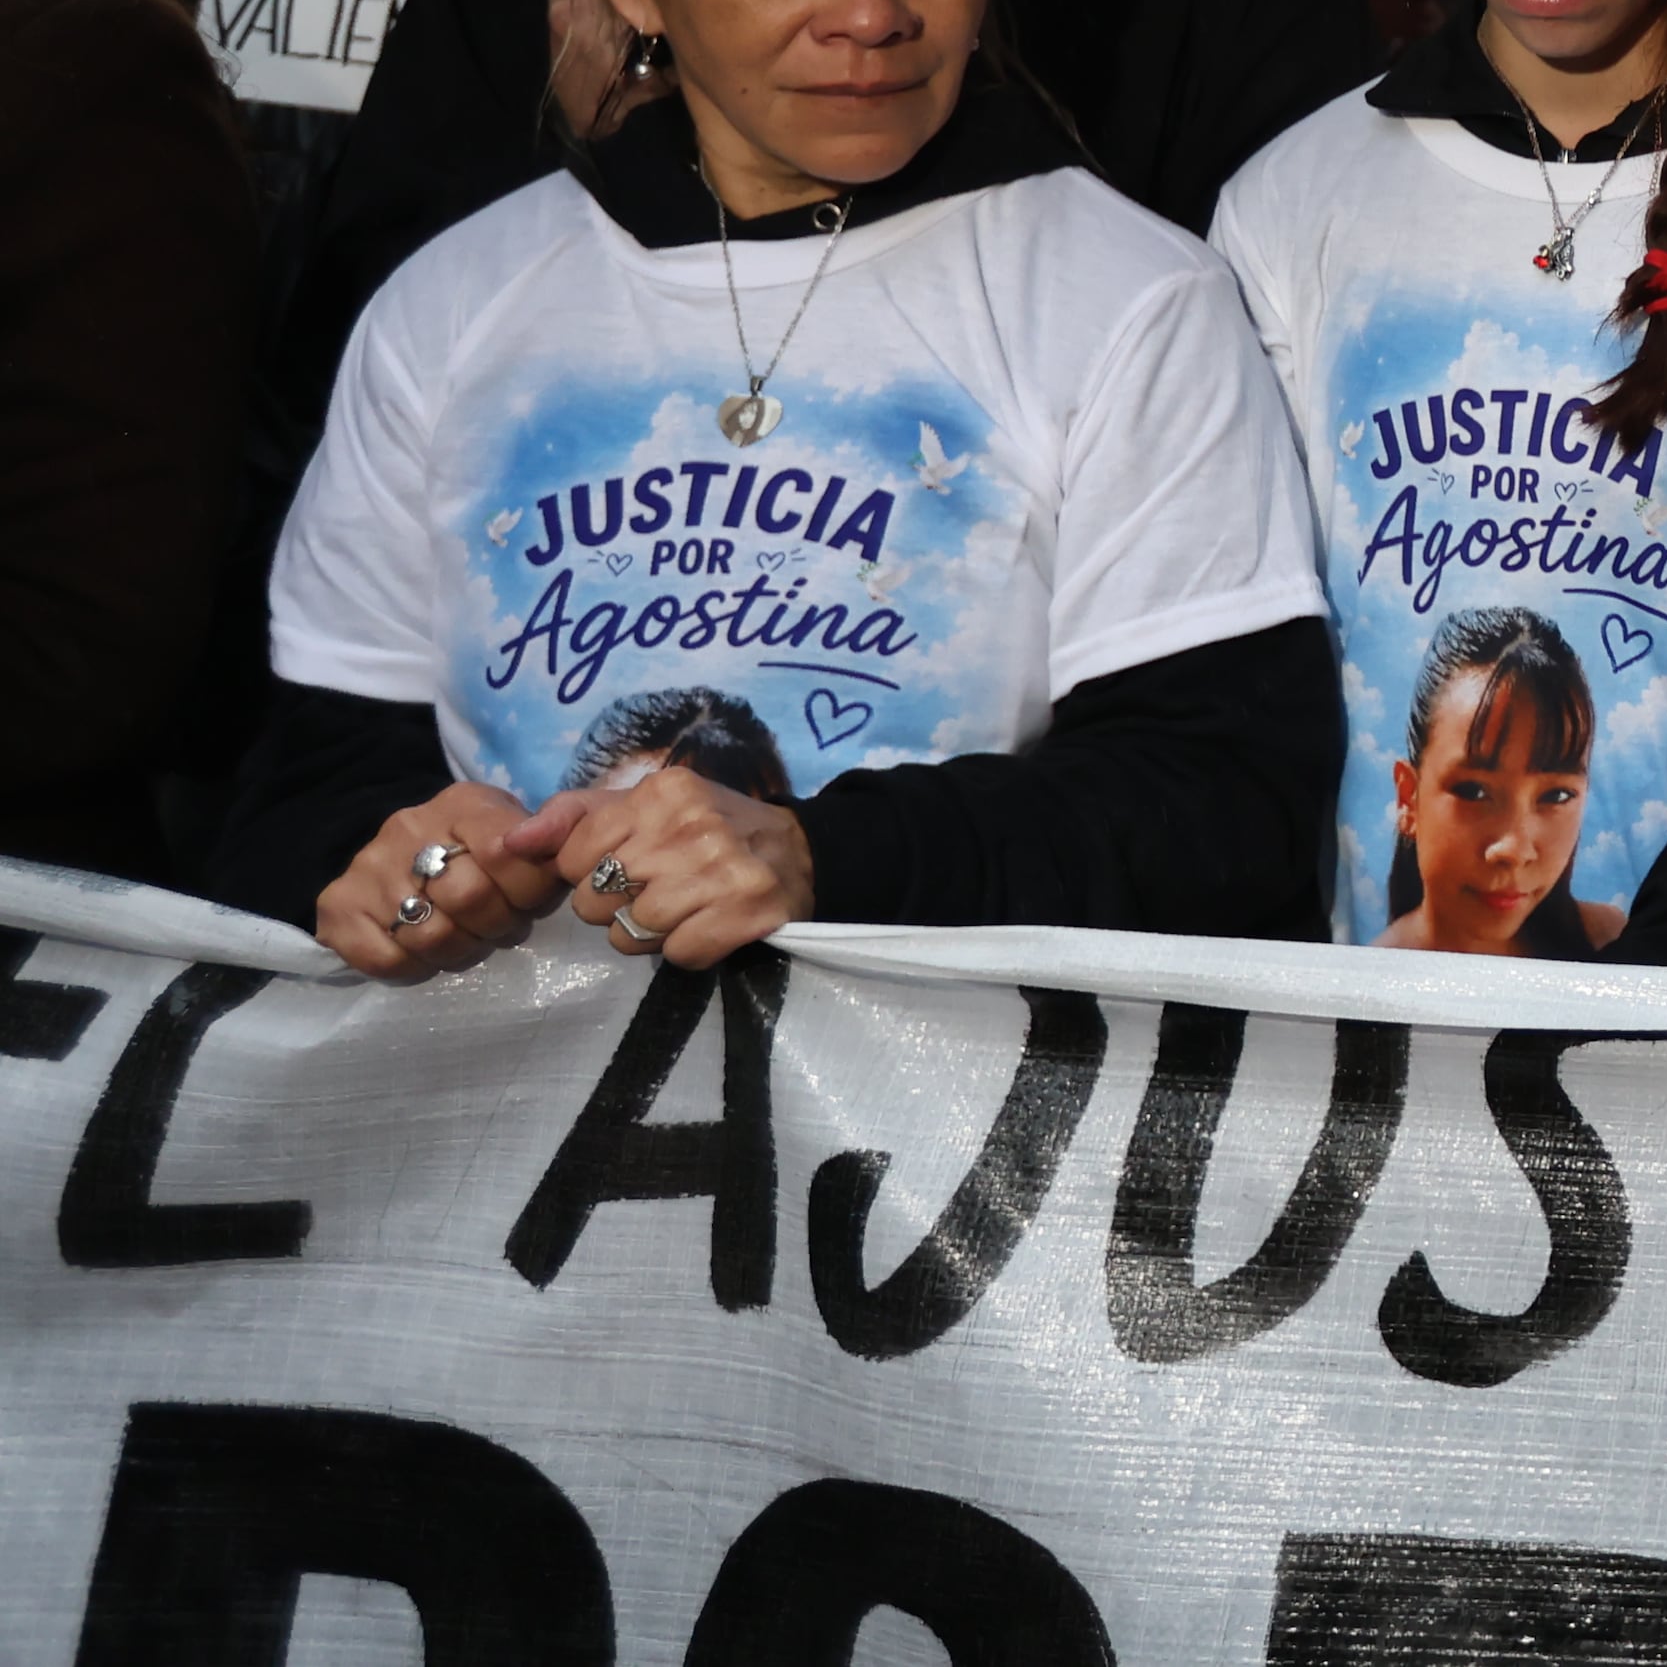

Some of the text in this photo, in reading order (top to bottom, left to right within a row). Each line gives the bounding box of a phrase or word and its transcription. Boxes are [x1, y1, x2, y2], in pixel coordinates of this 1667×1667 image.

[524, 461, 896, 567] JUSTICIA
[1470, 463, 1540, 504] POR
[649, 538, 734, 576] POR
[486, 568, 917, 705] Agostina
